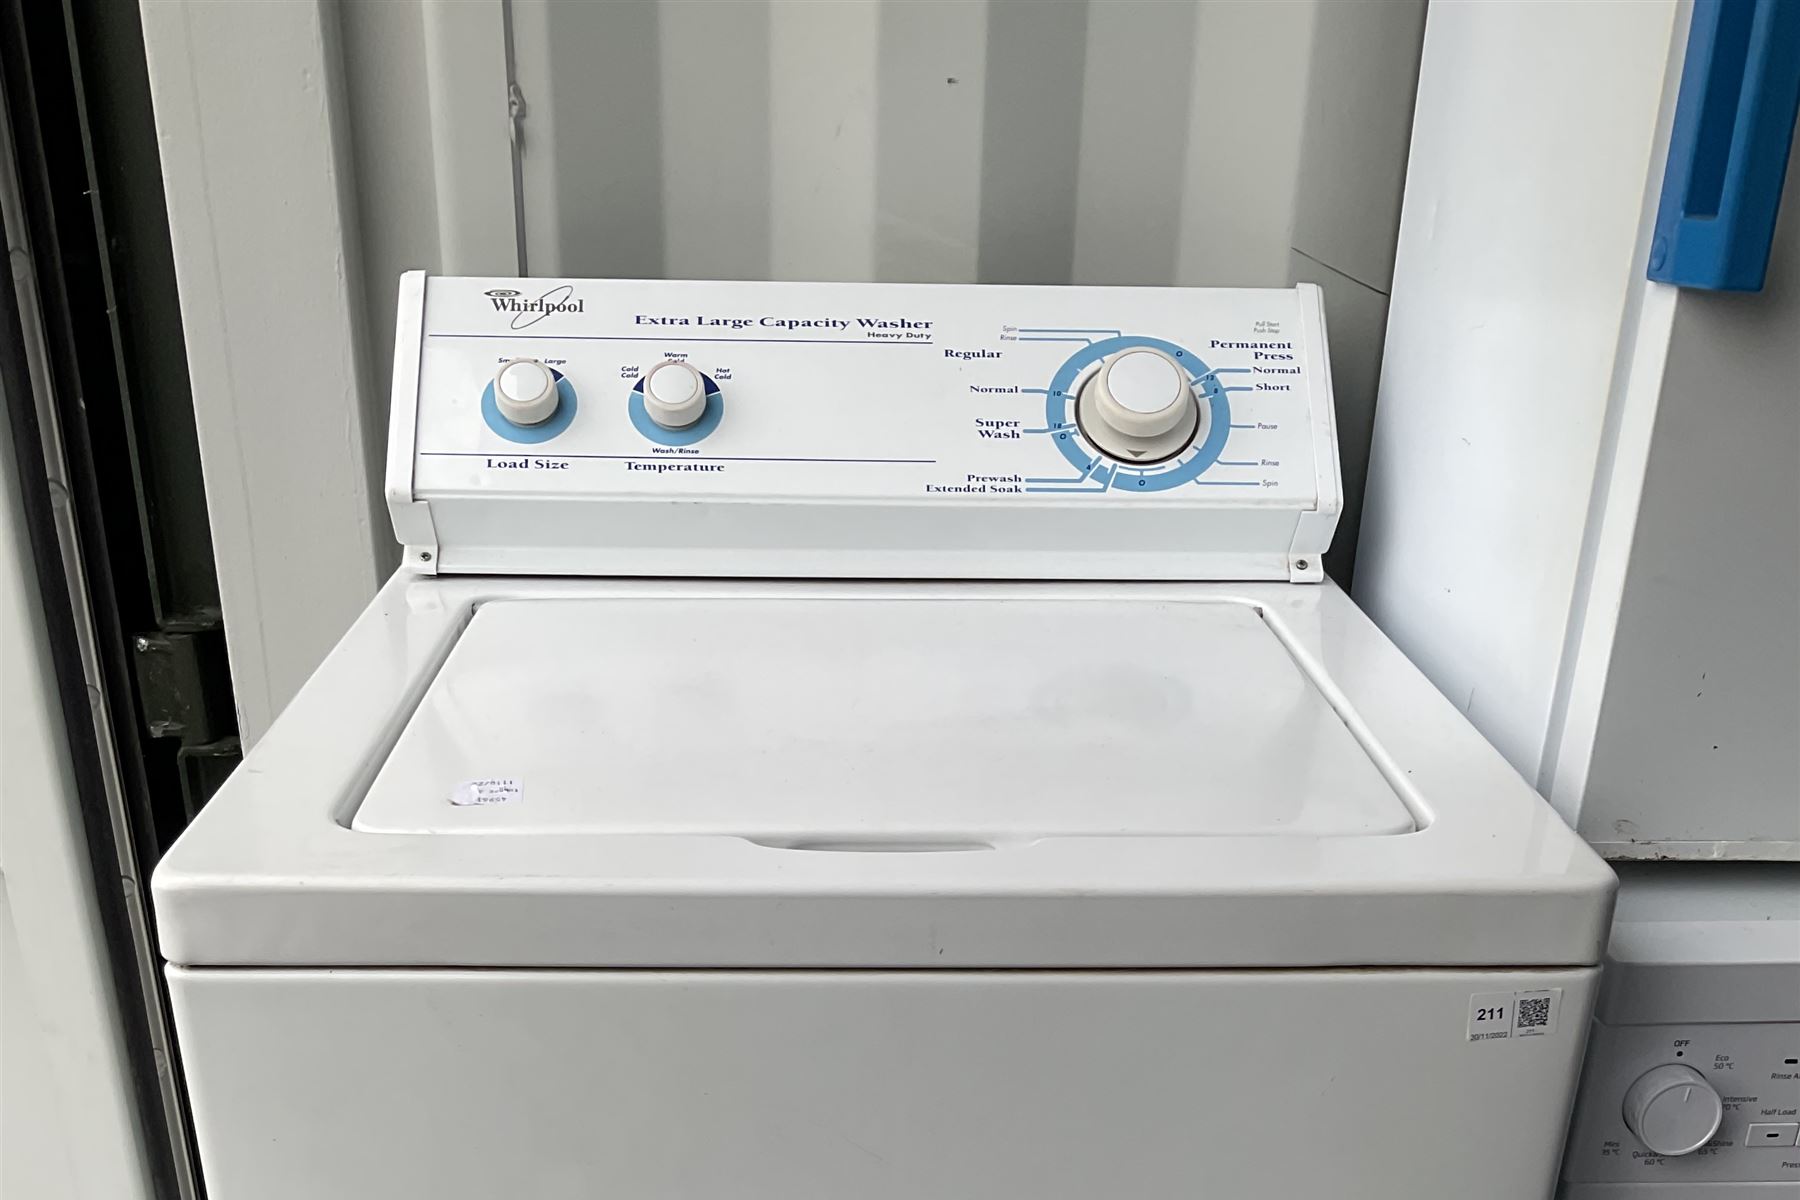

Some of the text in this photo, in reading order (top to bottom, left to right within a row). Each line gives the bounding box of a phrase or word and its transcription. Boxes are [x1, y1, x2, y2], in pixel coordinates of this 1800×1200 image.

[490, 298, 584, 316] Whirlpool
[635, 315, 933, 331] Extra Large Capacity Washer
[1002, 325, 1018, 333] Spin
[867, 332, 932, 340] Heavy Duty
[1210, 340, 1293, 349] Permanent
[944, 349, 1003, 360] Regular
[1253, 352, 1294, 361] Press
[1252, 367, 1301, 375] Normal
[969, 385, 1019, 394] Normal
[1255, 383, 1291, 391] Short
[975, 418, 1021, 428] Super
[978, 430, 1021, 439] Wash
[651, 447, 700, 455] Wash/Rinse
[486, 458, 570, 470] Load Size
[624, 461, 725, 474] Temperature
[1261, 459, 1280, 467] Rinse
[967, 474, 1022, 483] Prewash
[926, 484, 1023, 493] Extended Soak
[1262, 480, 1278, 488] Spin
[1477, 1007, 1504, 1021] 211
[1713, 1062, 1724, 1070] 50
[1723, 1095, 1758, 1103] Intensive
